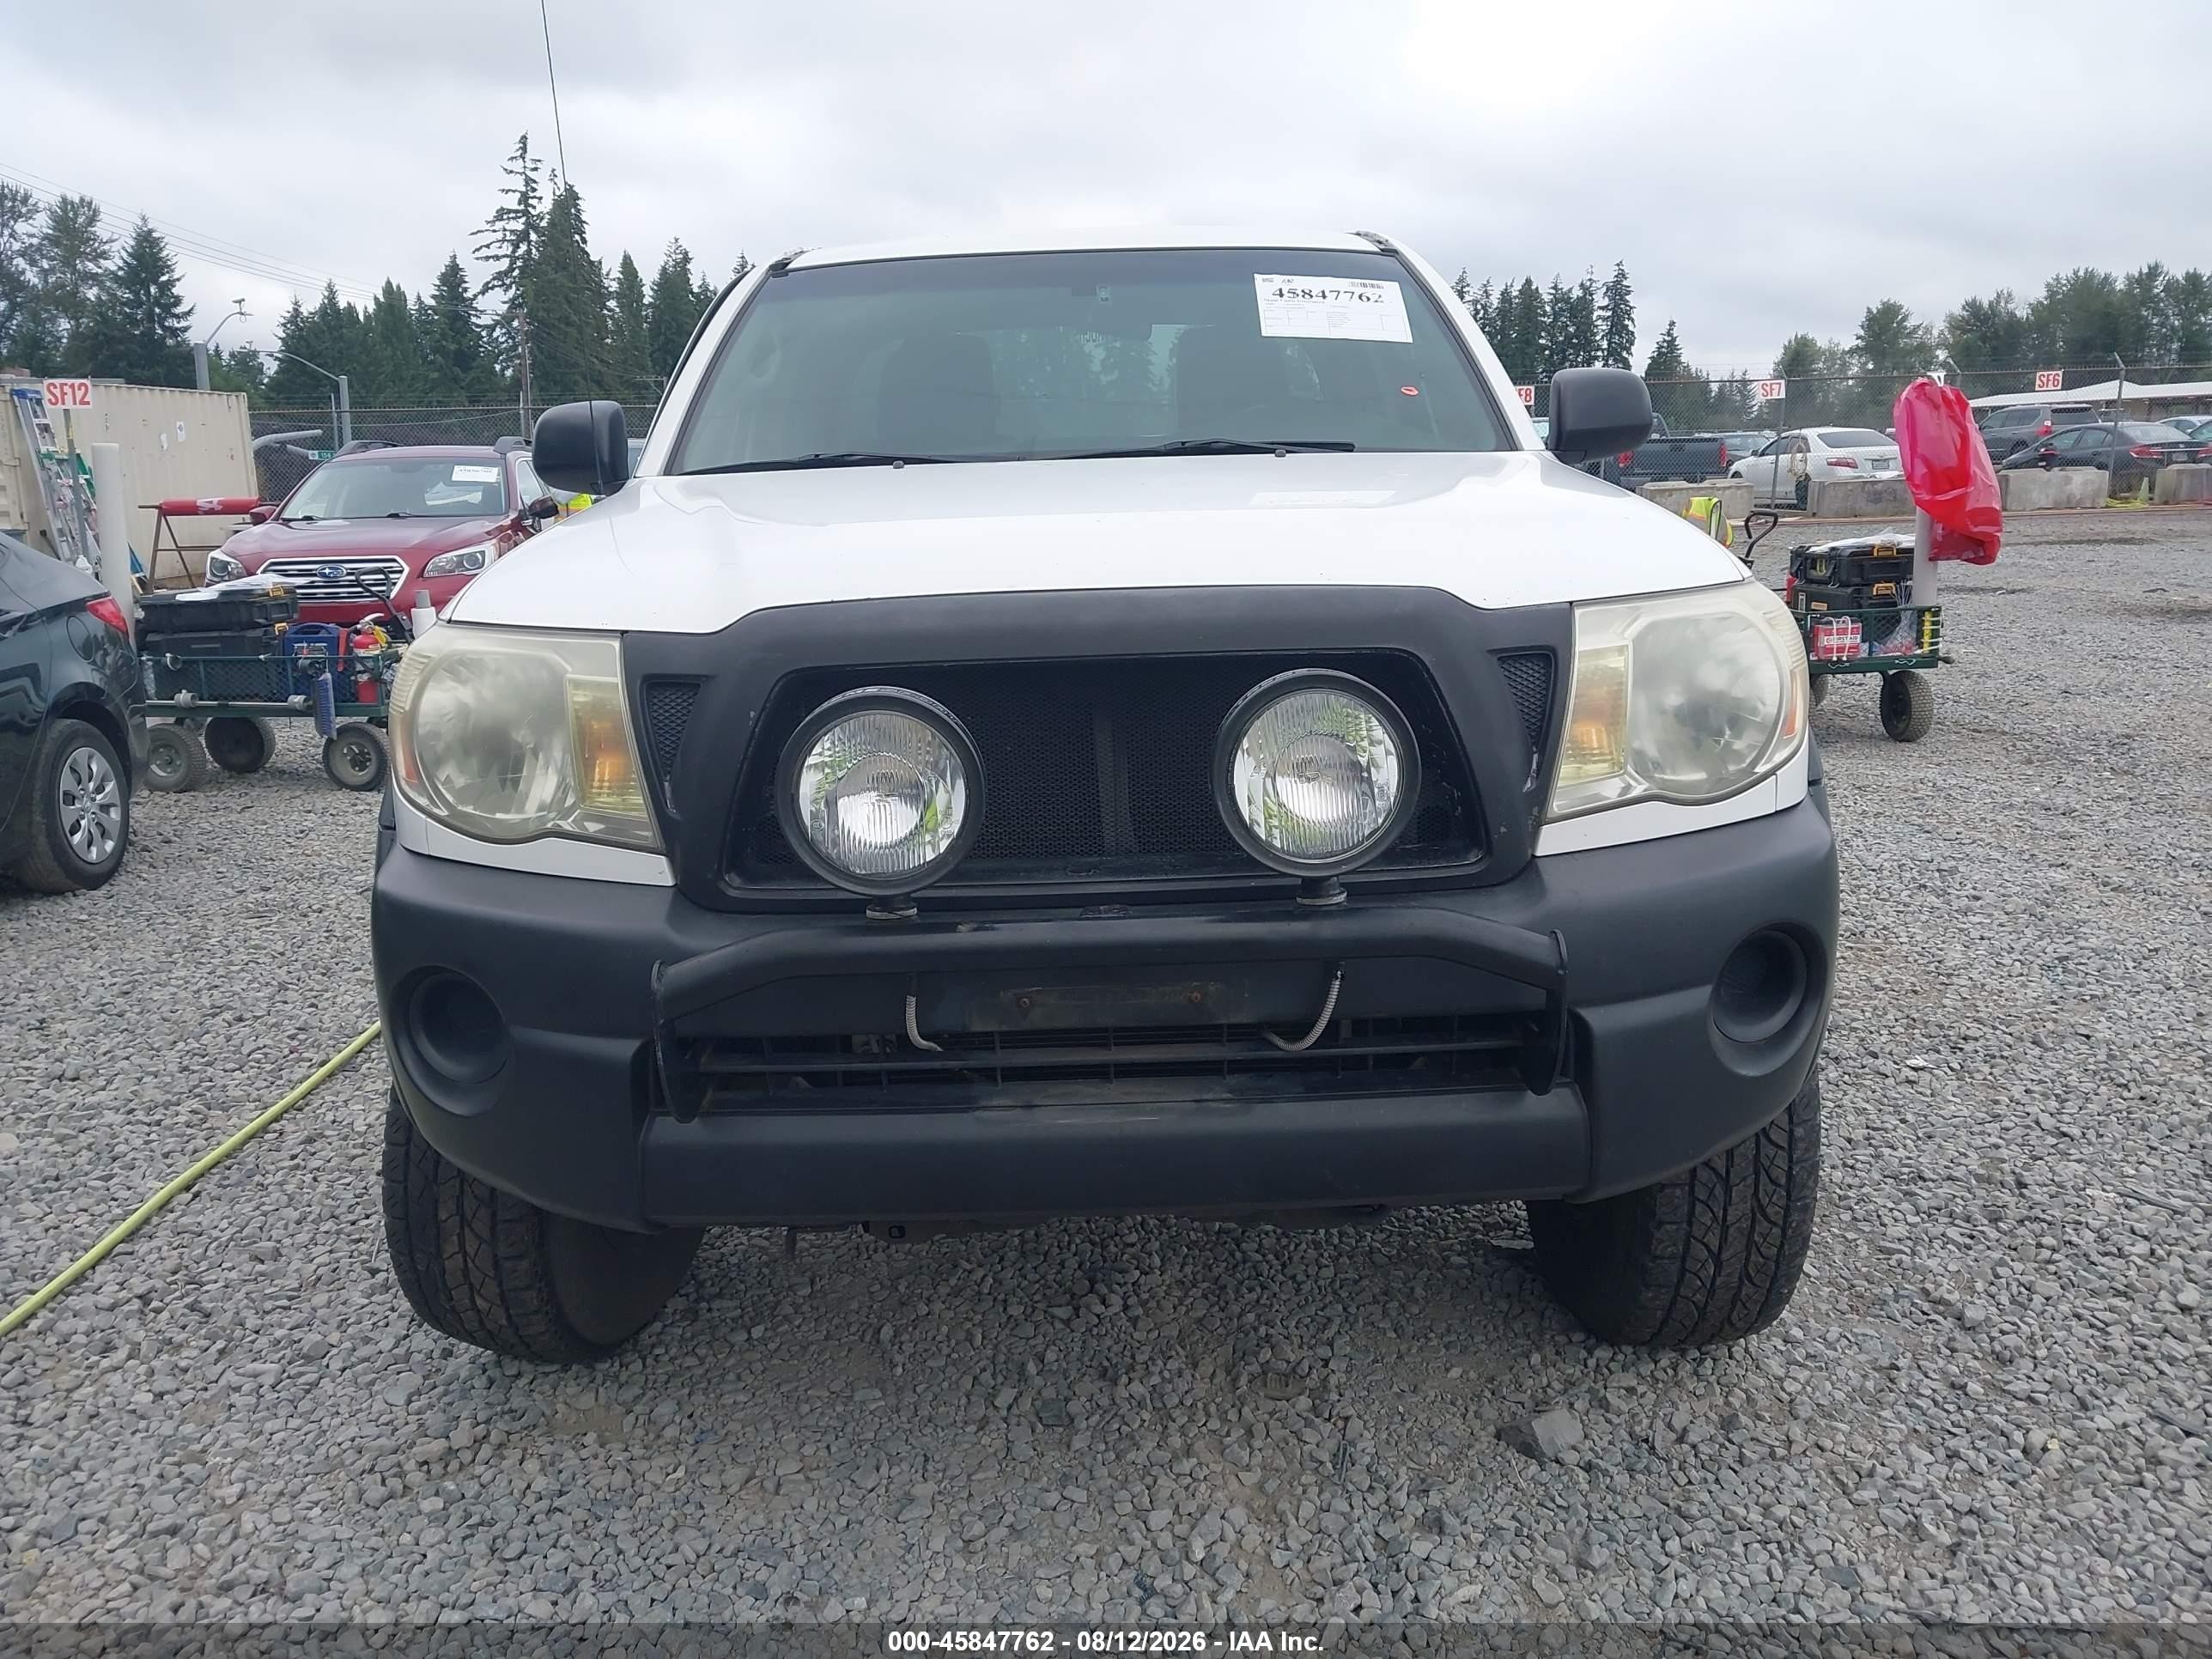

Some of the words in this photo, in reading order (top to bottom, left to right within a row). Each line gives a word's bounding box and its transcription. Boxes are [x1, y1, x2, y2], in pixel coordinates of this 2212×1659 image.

[1272, 287, 1384, 303] 45847762
[2038, 373, 2060, 388] SF6
[46, 382, 90, 405] SF12
[1517, 387, 1533, 403] F8
[1761, 381, 1782, 398] SF7
